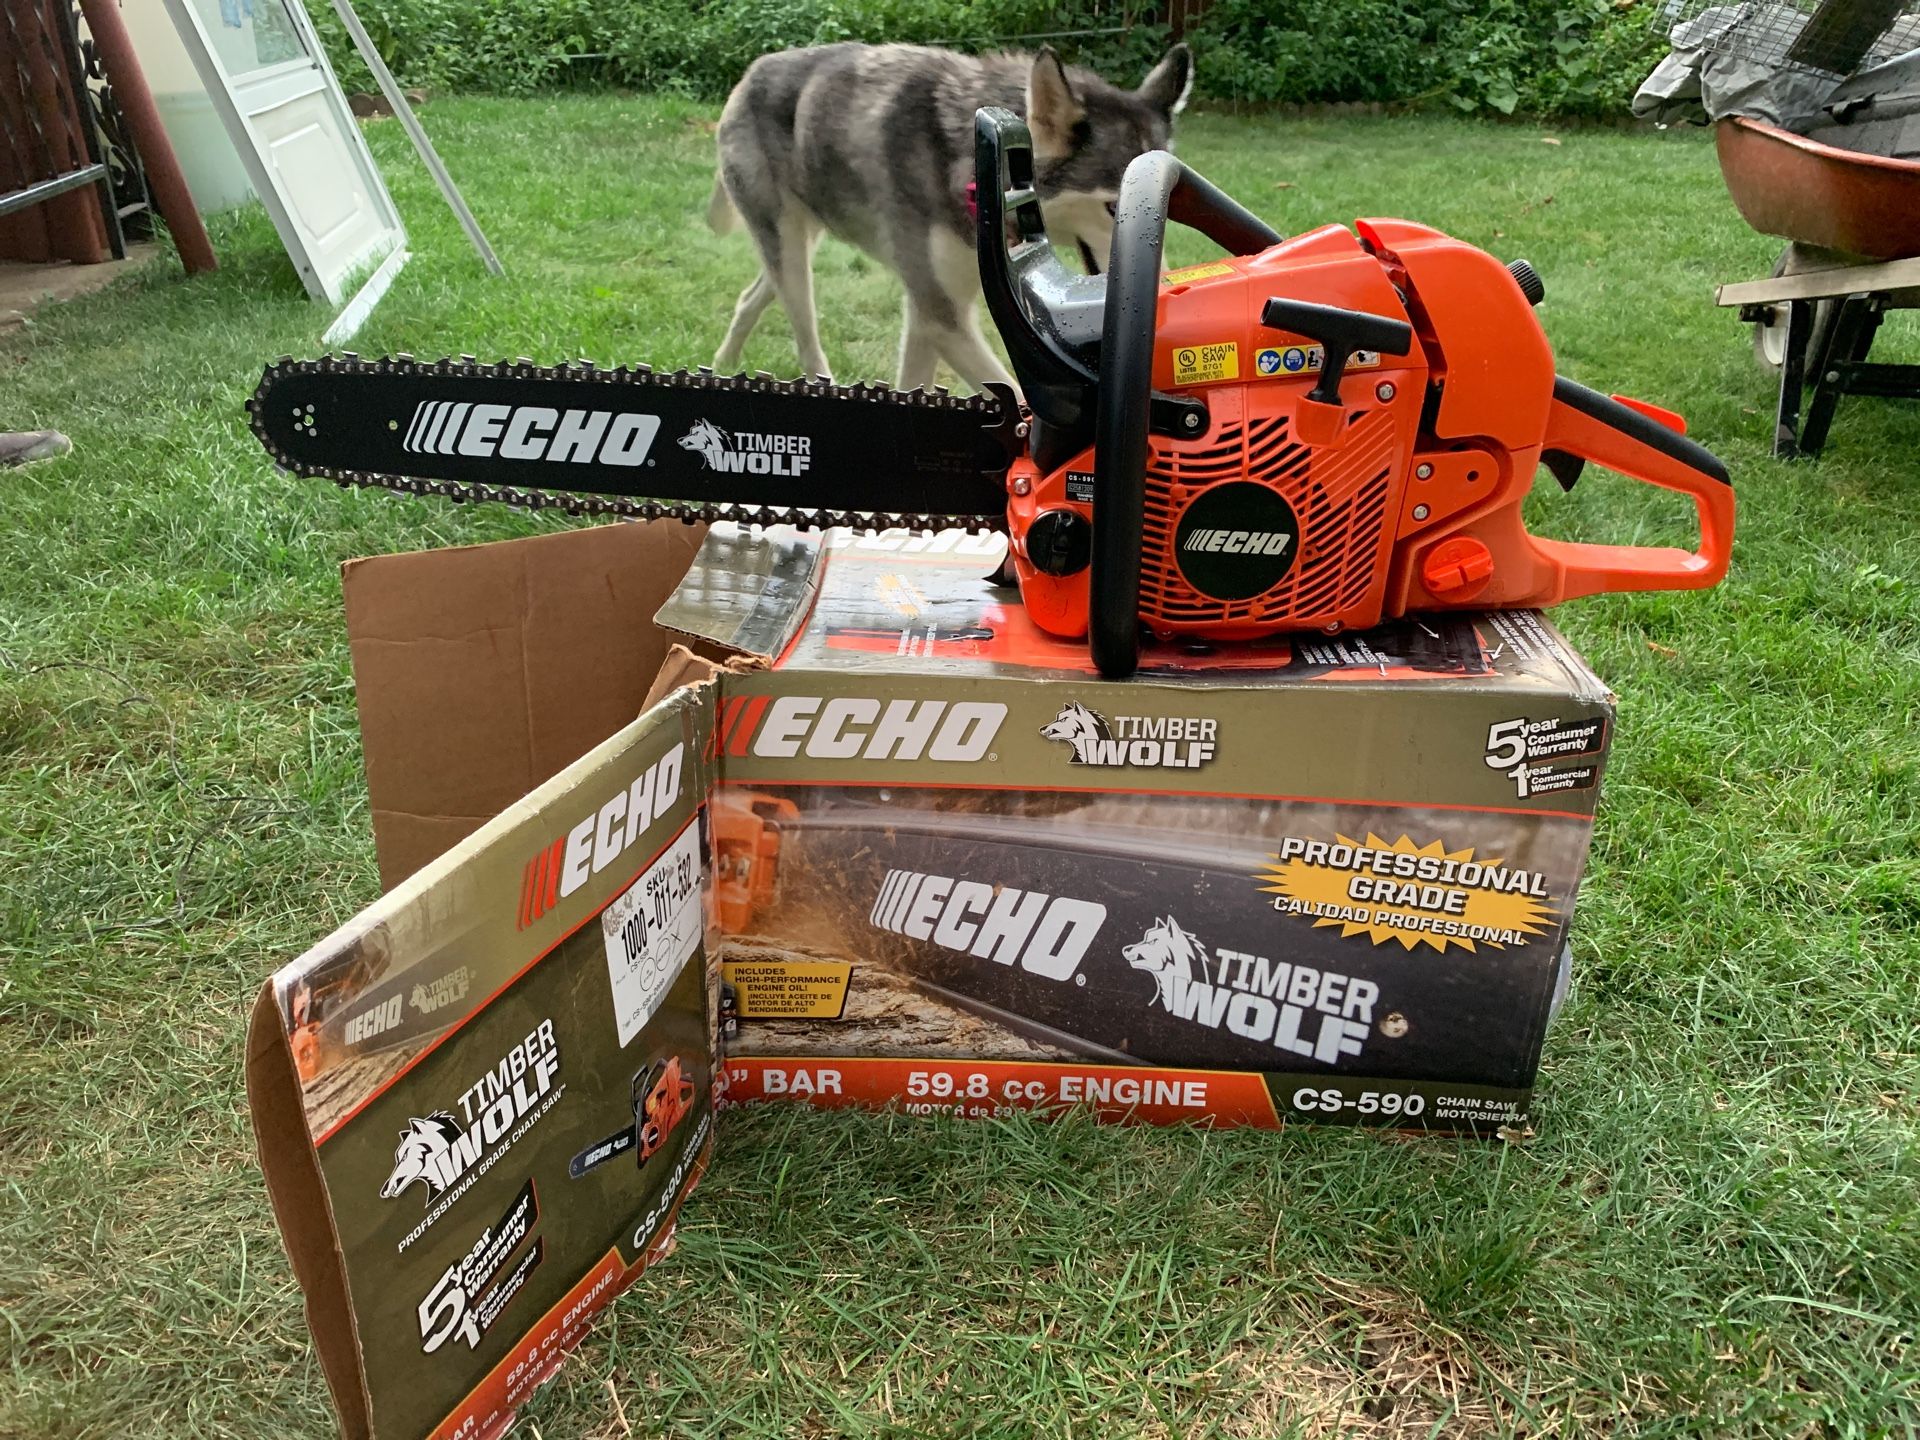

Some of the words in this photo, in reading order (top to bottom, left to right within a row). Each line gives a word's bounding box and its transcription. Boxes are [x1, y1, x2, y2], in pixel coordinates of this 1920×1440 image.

[1201, 344, 1236, 355] CHAIN
[1202, 353, 1226, 363] SAW
[455, 403, 661, 467] ECHO
[733, 432, 811, 455] TIMBER
[712, 450, 810, 477] WOLF
[1204, 530, 1291, 555] ECHO
[752, 696, 1008, 762] ECHO
[1114, 716, 1217, 741] TIMBER
[1485, 719, 1526, 768] 5
[1519, 718, 1560, 738] year
[1527, 725, 1597, 746] Consumer
[1527, 738, 1588, 757] Warranty
[1085, 739, 1215, 768] WOLF
[1507, 763, 1528, 797] 1
[1525, 766, 1553, 778] year
[1531, 769, 1590, 785] Commercial
[1531, 779, 1575, 793] Warranty
[560, 742, 684, 898] ECHO
[646, 867, 666, 897] SKU
[1279, 837, 1548, 896] PROFESSIONAL
[621, 853, 691, 965] 1000-011-532
[1349, 877, 1466, 913] GRADE
[905, 875, 1107, 983] ECHO
[1273, 896, 1369, 924] CALIDAD
[1374, 910, 1525, 946] PROFESIONAL
[420, 980, 470, 1013] WOLF
[429, 966, 468, 995] TIMBER
[1214, 948, 1379, 1021] TIMBER
[352, 994, 403, 1042] ECHO
[1168, 977, 1371, 1064] WOLF
[457, 1018, 556, 1123] TIMBER
[762, 1069, 843, 1095] BAR
[907, 1071, 989, 1099] 59.8
[1003, 1079, 1047, 1101] cc
[1059, 1076, 1208, 1108] ENGINE
[435, 1047, 558, 1187] WOLF
[1292, 1088, 1425, 1116] CS-590
[1435, 1108, 1528, 1123] MOTOSIERRA
[1436, 1096, 1481, 1108] CHAIN
[1484, 1099, 1517, 1112] SAW
[398, 1172, 478, 1253] PROFESSIONAL
[479, 1141, 511, 1175] GRADE
[511, 1110, 541, 1141] CHAIN
[633, 1164, 682, 1249] CS-590
[464, 1195, 529, 1287] Consumer
[466, 1218, 526, 1298] Warranty
[418, 1264, 466, 1353] 5
[450, 1227, 491, 1287] year
[470, 1282, 500, 1323] year
[480, 1246, 537, 1322] Commercial
[482, 1273, 525, 1329] Warranty
[507, 1347, 538, 1388] 59.8
[541, 1328, 559, 1349] cc
[562, 1271, 613, 1329] ENGINE
[507, 1360, 544, 1404] MOTOR
[545, 1347, 558, 1361] de
[447, 1415, 474, 1440] AR
[482, 1410, 498, 1429] cm
